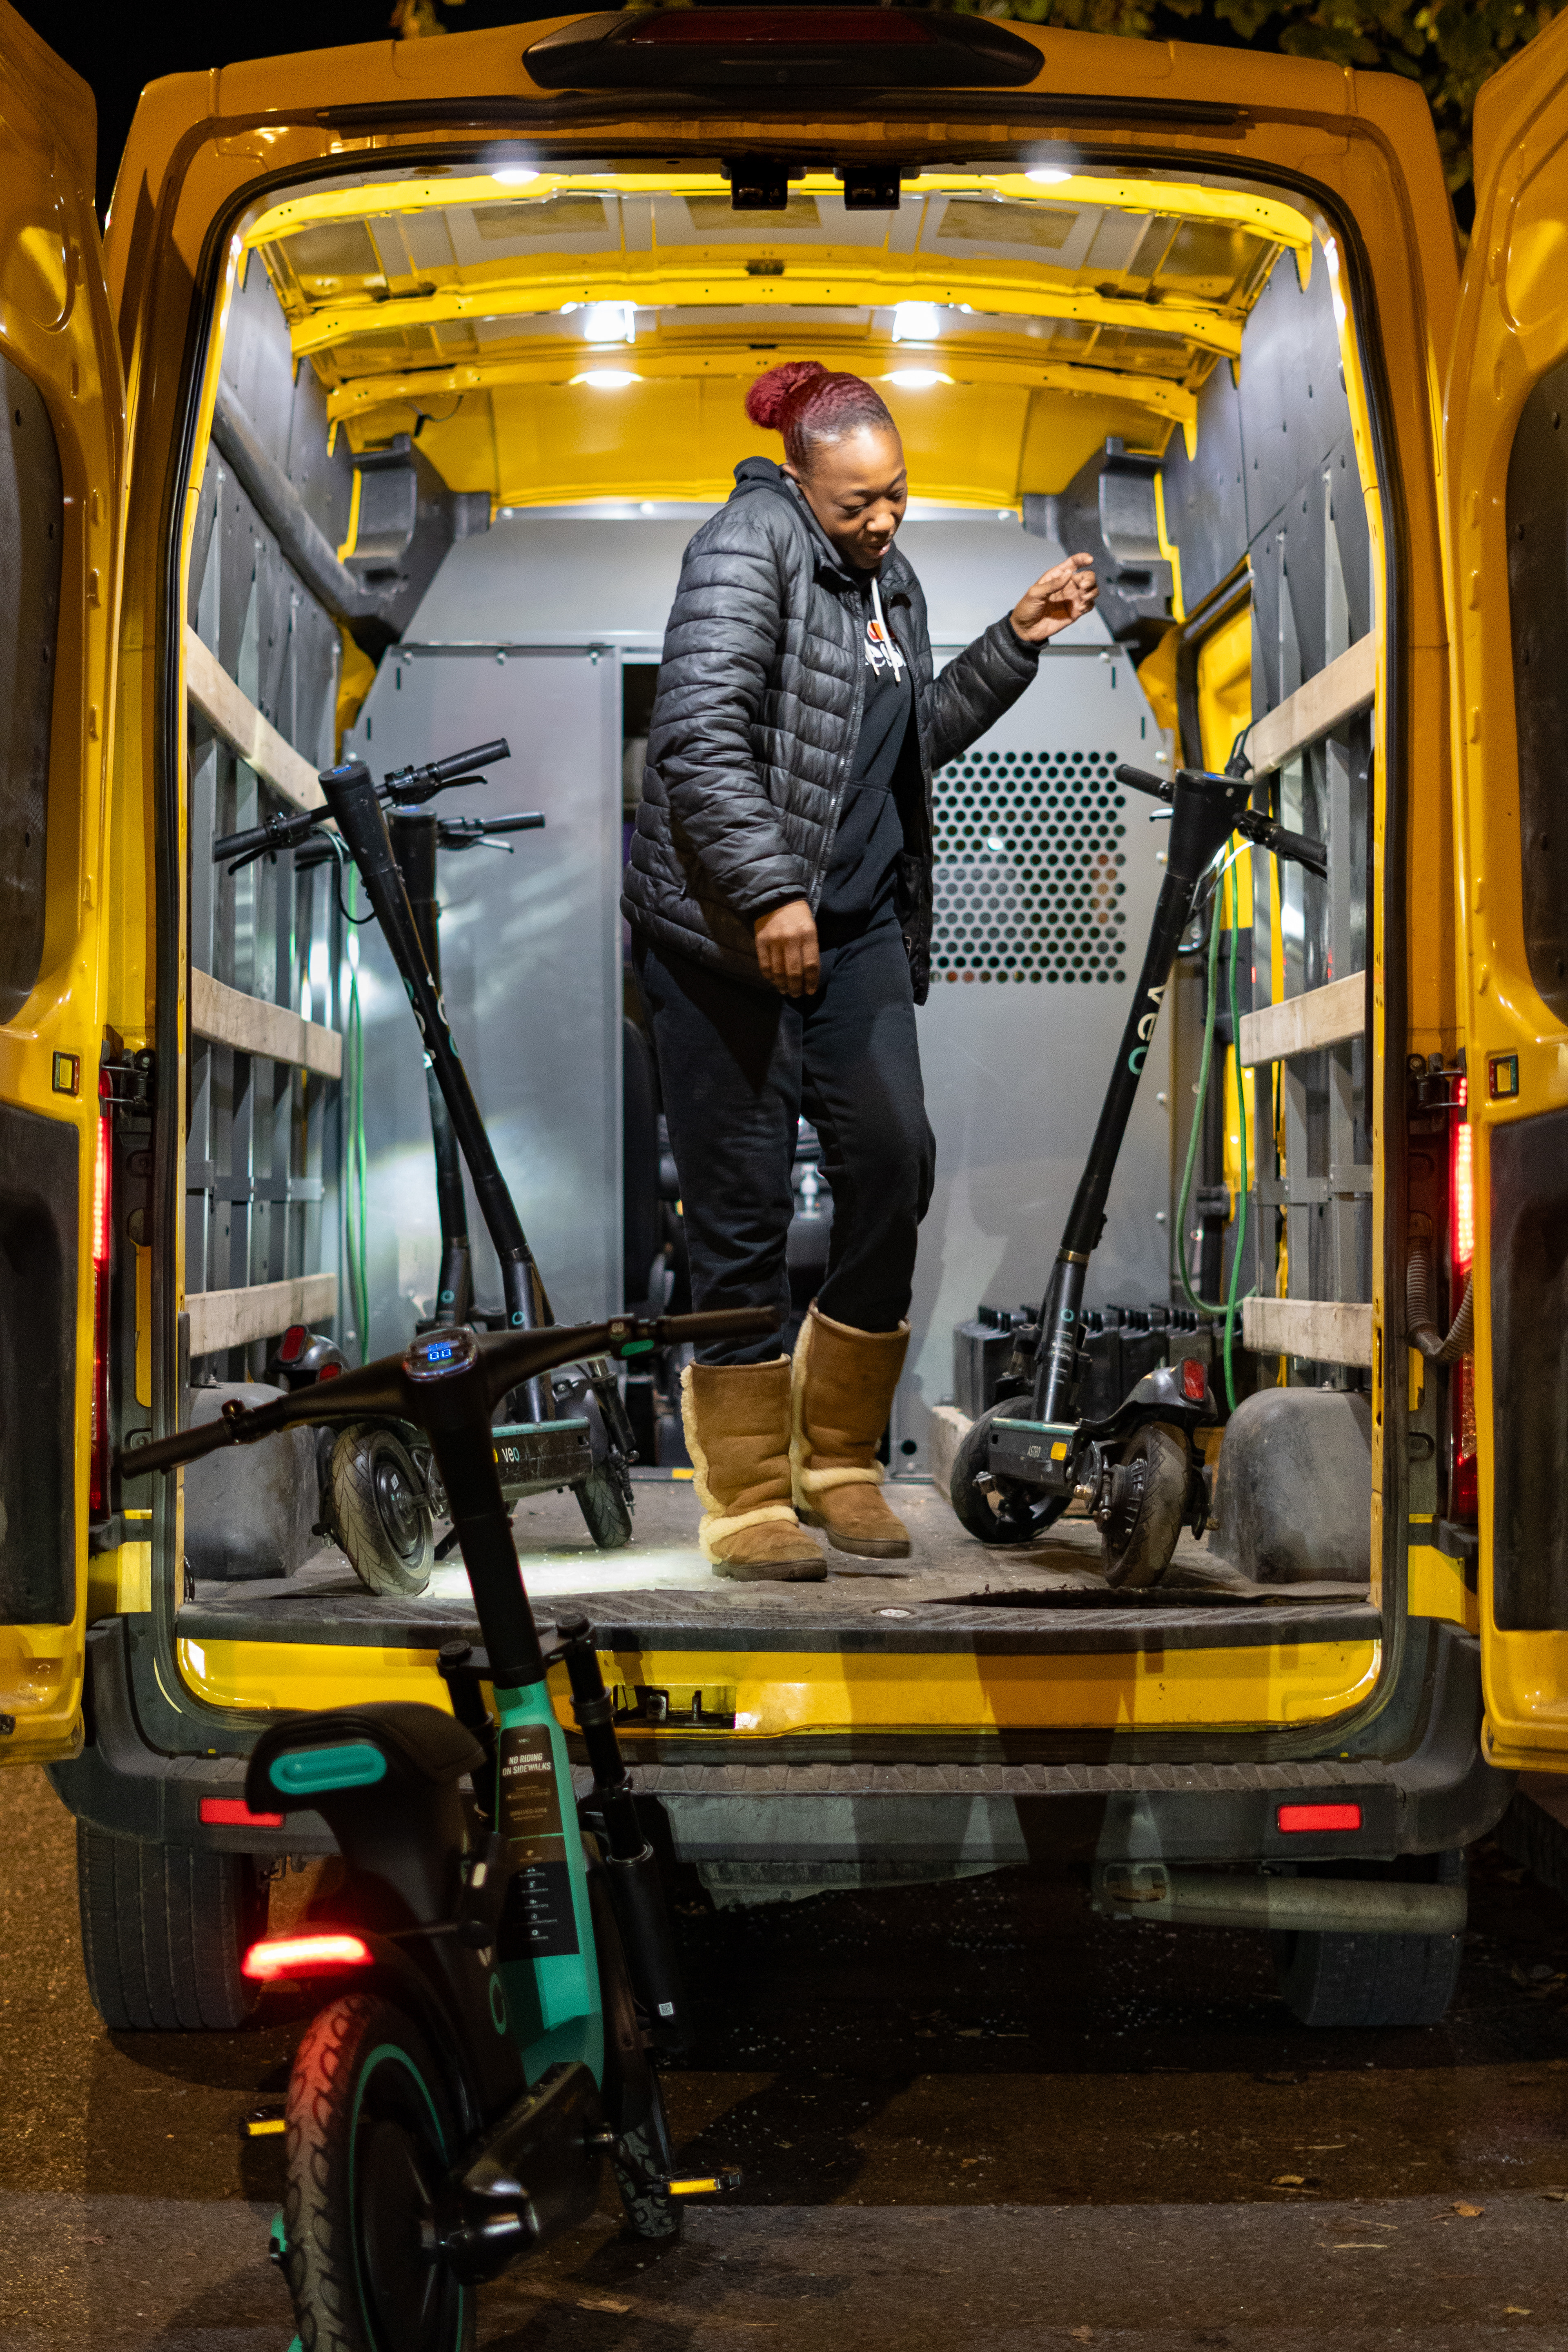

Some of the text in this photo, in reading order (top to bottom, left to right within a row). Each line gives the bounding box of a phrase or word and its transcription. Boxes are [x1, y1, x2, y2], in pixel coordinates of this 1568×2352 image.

[501, 1447, 520, 1463] veo
[508, 1753, 543, 1765] NO RIDING
[502, 1762, 551, 1776] ON SIDEWALKS
